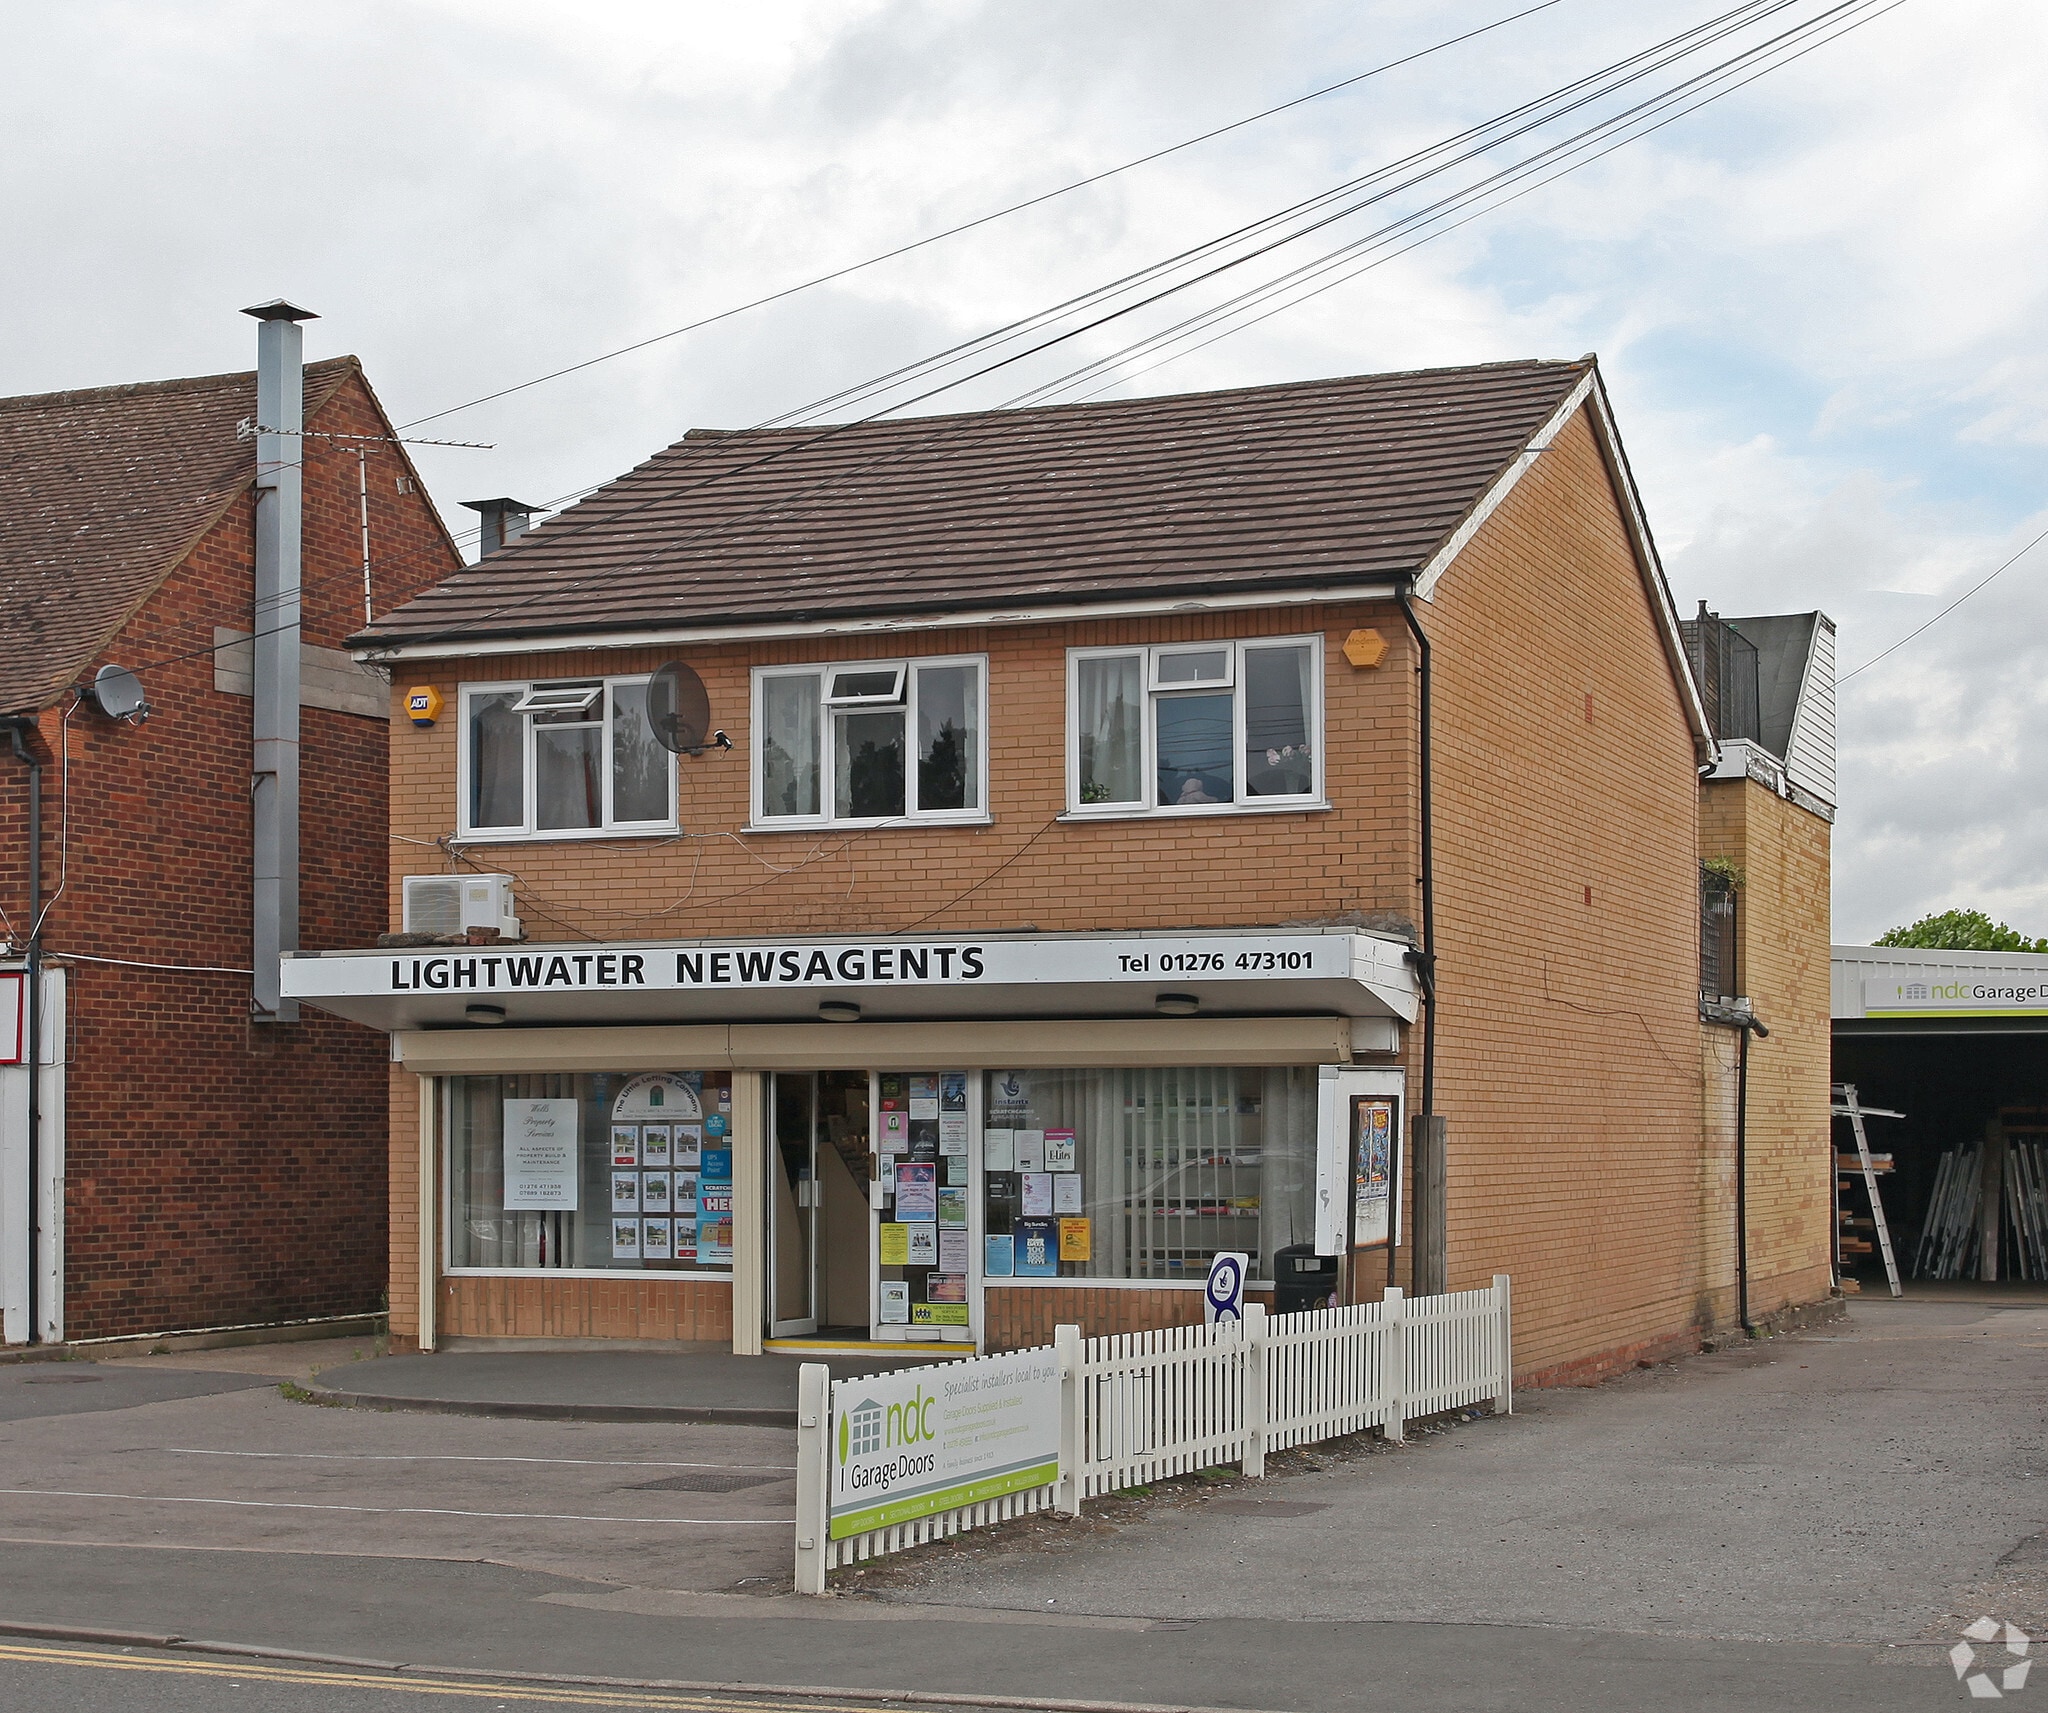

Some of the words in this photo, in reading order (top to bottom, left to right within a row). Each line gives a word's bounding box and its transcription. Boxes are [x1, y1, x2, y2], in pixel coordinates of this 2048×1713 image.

[411, 697, 428, 709] ADT
[391, 954, 645, 990] LIGHTWATER
[676, 946, 985, 984] NEWSAGENTS
[1118, 954, 1150, 972] Tel
[1160, 953, 1225, 972] 01276
[1235, 951, 1314, 970] 473101
[1932, 981, 1970, 999] ndc
[1973, 984, 2037, 1002] Garage
[616, 1099, 625, 1113] The
[622, 1080, 641, 1098] Little
[641, 1074, 673, 1085] Letting
[674, 1080, 698, 1114] Company
[522, 1116, 556, 1127] Property
[524, 1128, 555, 1138] Services
[944, 1375, 980, 1401] Specialist
[981, 1370, 1014, 1390] installers
[1015, 1365, 1031, 1384] local
[1033, 1366, 1041, 1380] to
[886, 1383, 936, 1449] ndc
[943, 1408, 960, 1420] Garage
[962, 1405, 976, 1417] Doors
[851, 1462, 897, 1490] Garage
[898, 1453, 935, 1479] Doors
